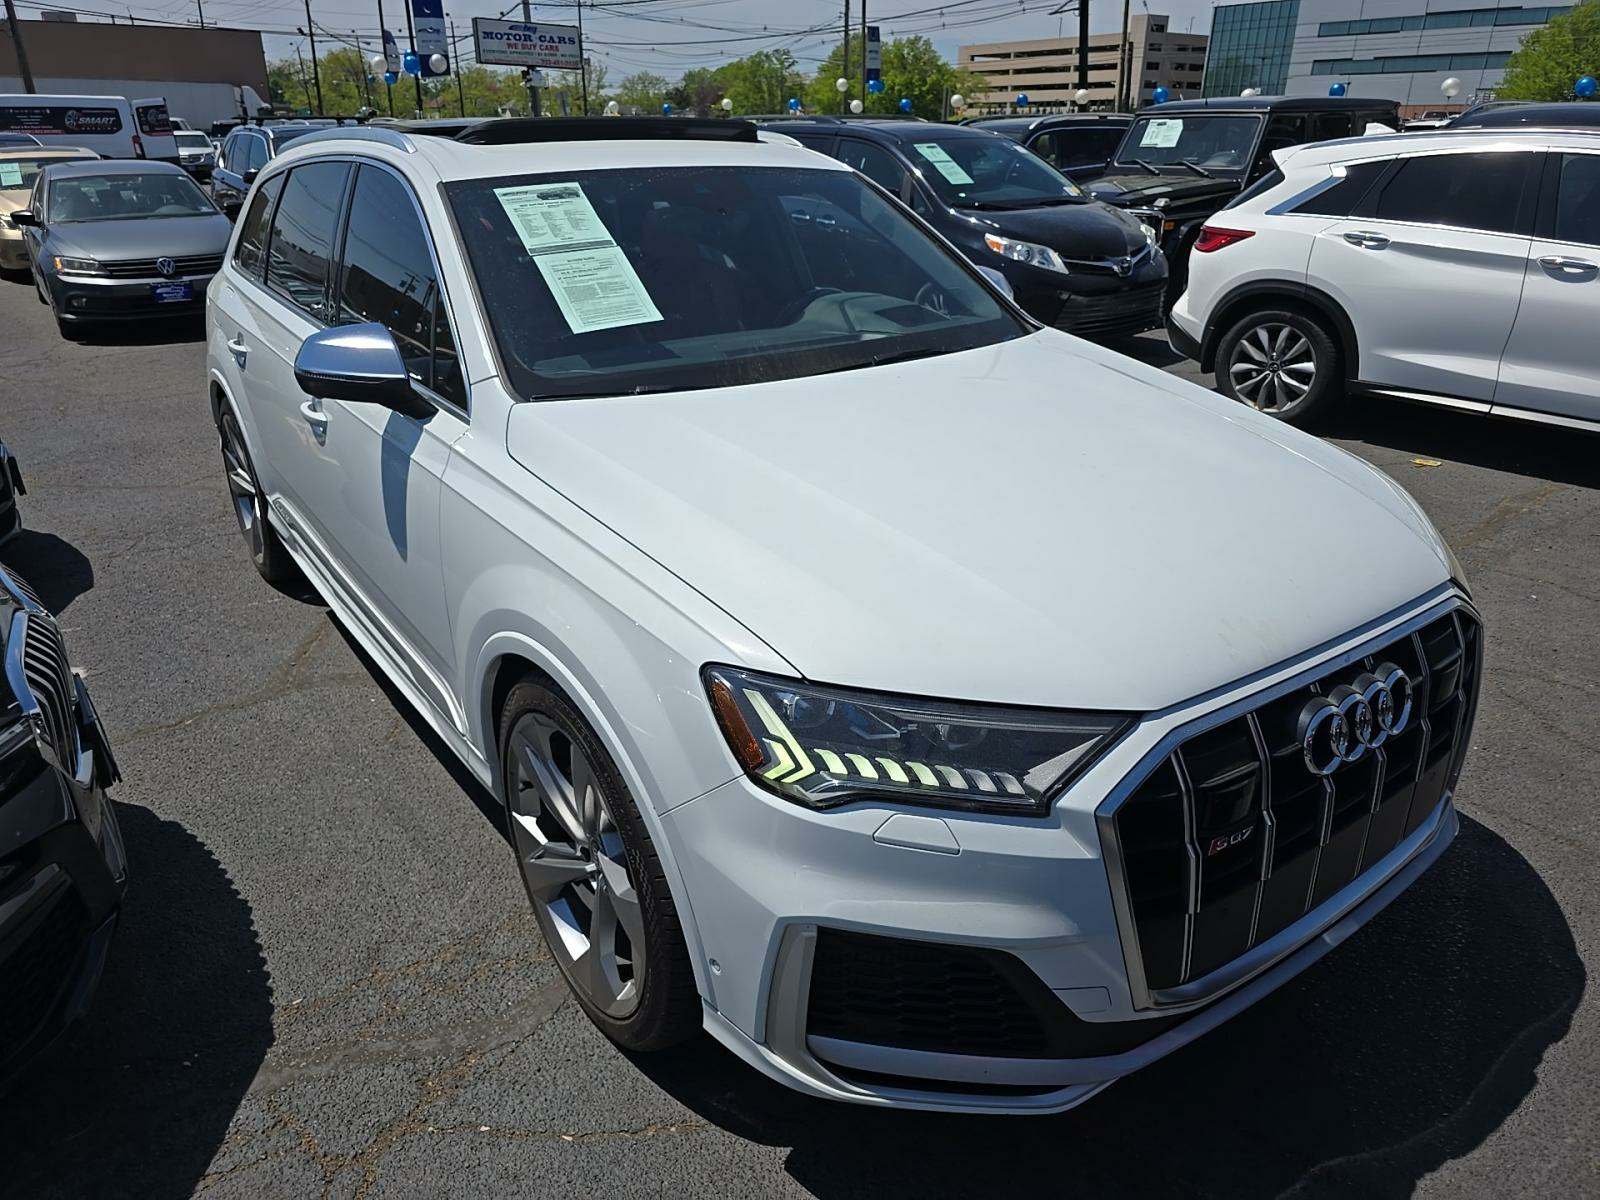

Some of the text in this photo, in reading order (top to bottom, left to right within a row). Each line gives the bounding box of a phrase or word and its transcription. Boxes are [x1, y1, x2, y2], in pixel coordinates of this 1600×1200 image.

[482, 31, 576, 45] MOTOR CARS
[506, 42, 560, 52] WE BUY CARS
[78, 116, 117, 125] SMART
[1213, 825, 1254, 852] SQ7
